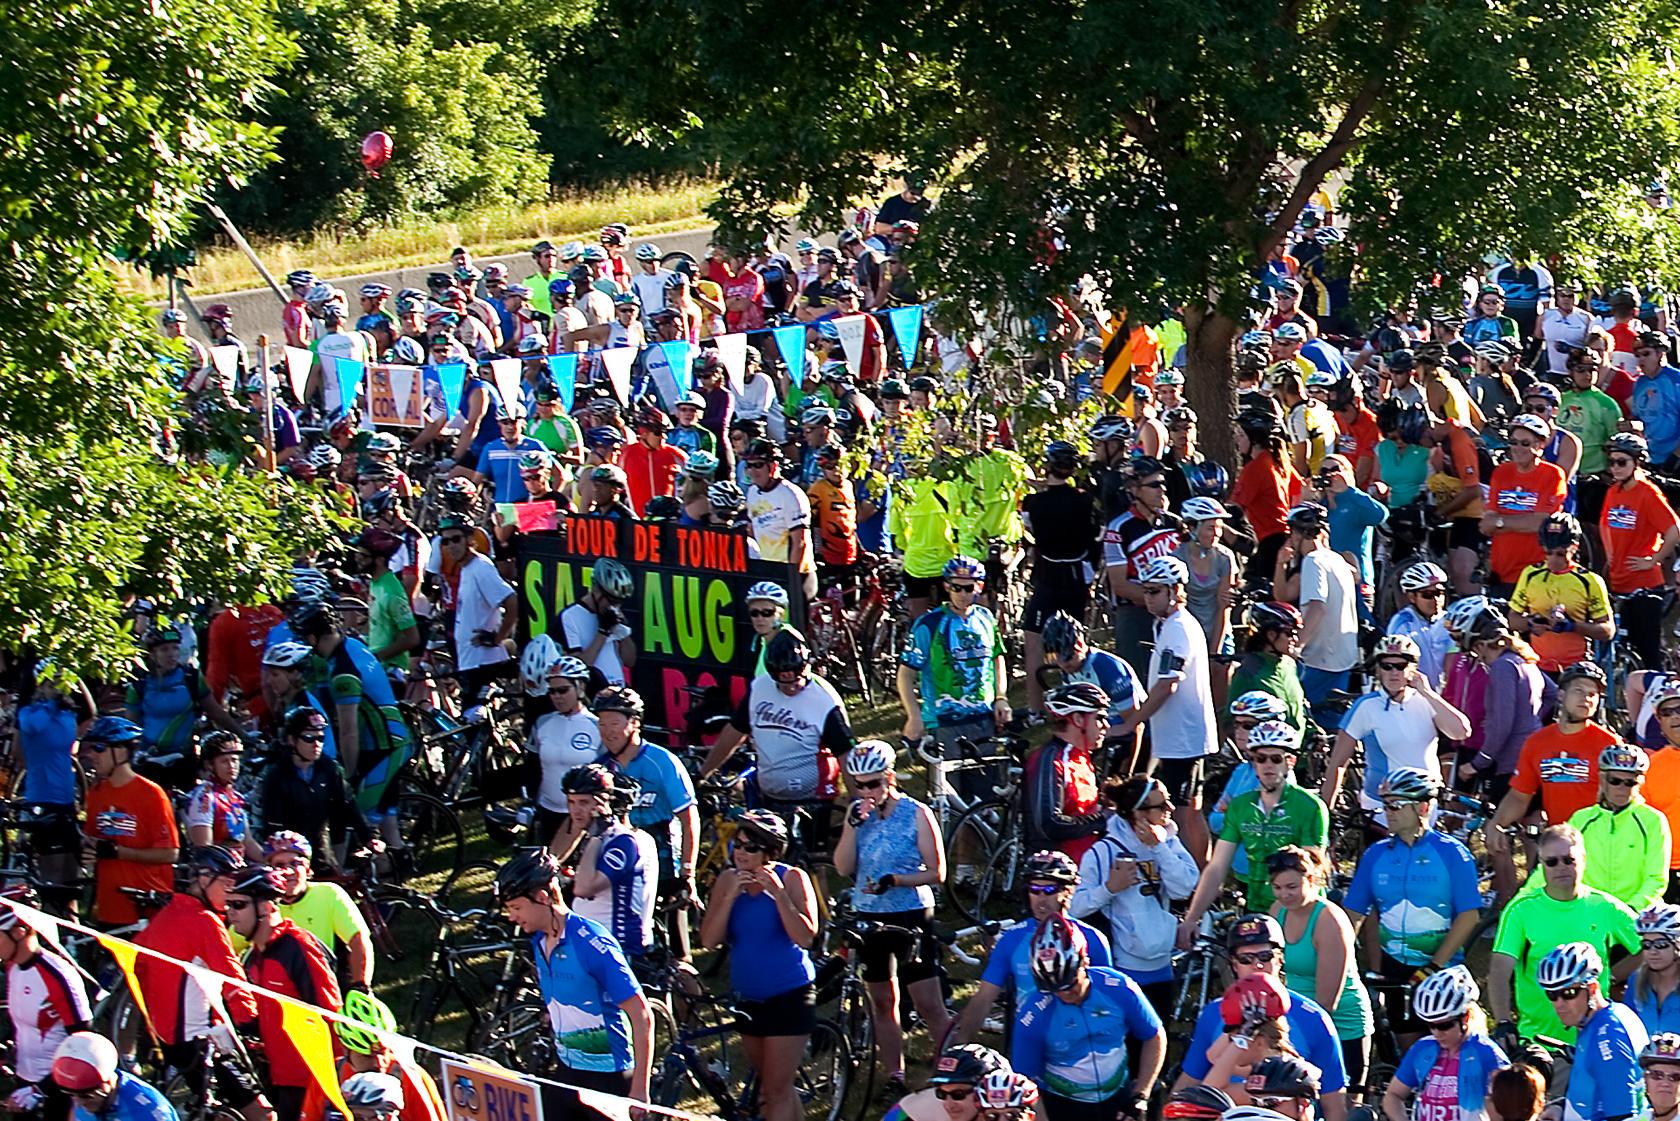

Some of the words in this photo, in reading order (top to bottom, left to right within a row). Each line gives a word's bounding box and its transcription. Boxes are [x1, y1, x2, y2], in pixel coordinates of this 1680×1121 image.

[373, 397, 421, 421] CORAL
[566, 517, 616, 558] TOUR
[634, 524, 661, 563] DE
[677, 528, 747, 573] TONKA
[643, 571, 735, 664] AUG
